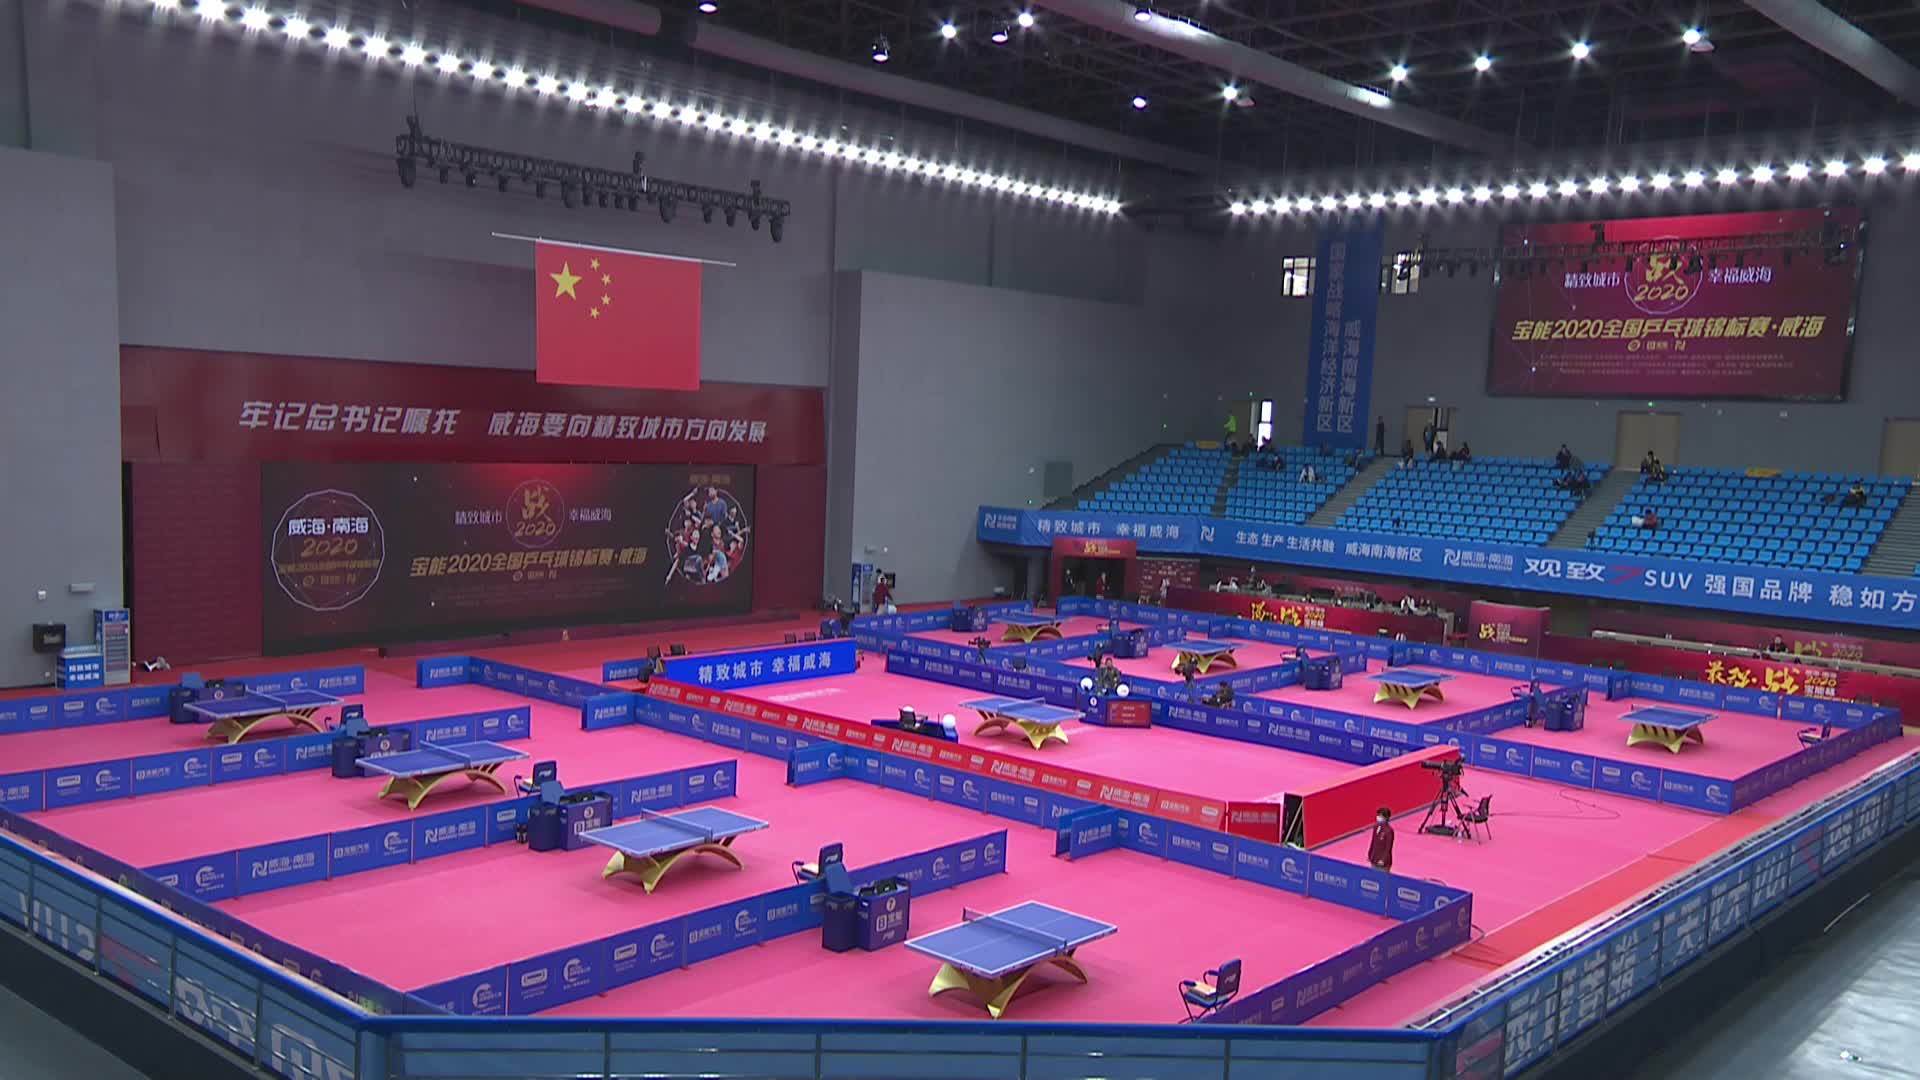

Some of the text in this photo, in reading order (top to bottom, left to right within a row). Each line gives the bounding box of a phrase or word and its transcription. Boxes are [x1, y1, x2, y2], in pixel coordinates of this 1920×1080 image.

[1564, 271, 1620, 288] 精致城市
[1708, 267, 1773, 284] 幸福威海
[1634, 284, 1689, 301] 2020
[239, 400, 768, 443] 牢记总书记嘱托 威海要向精致城市方向发展
[288, 516, 369, 536] 威海·南海
[514, 520, 557, 537] 2020
[1037, 519, 1100, 535] 精致城市
[1116, 522, 1180, 538] 幸福威海
[301, 538, 359, 557] 2020
[1236, 531, 1423, 562] 生态 生产 生活共融 威海南海新区
[1524, 558, 1918, 613] 观致 SUV 强国品牌 稳如方
[698, 651, 833, 685] 精致城市 幸福威海
[1805, 676, 1837, 688] 2020
